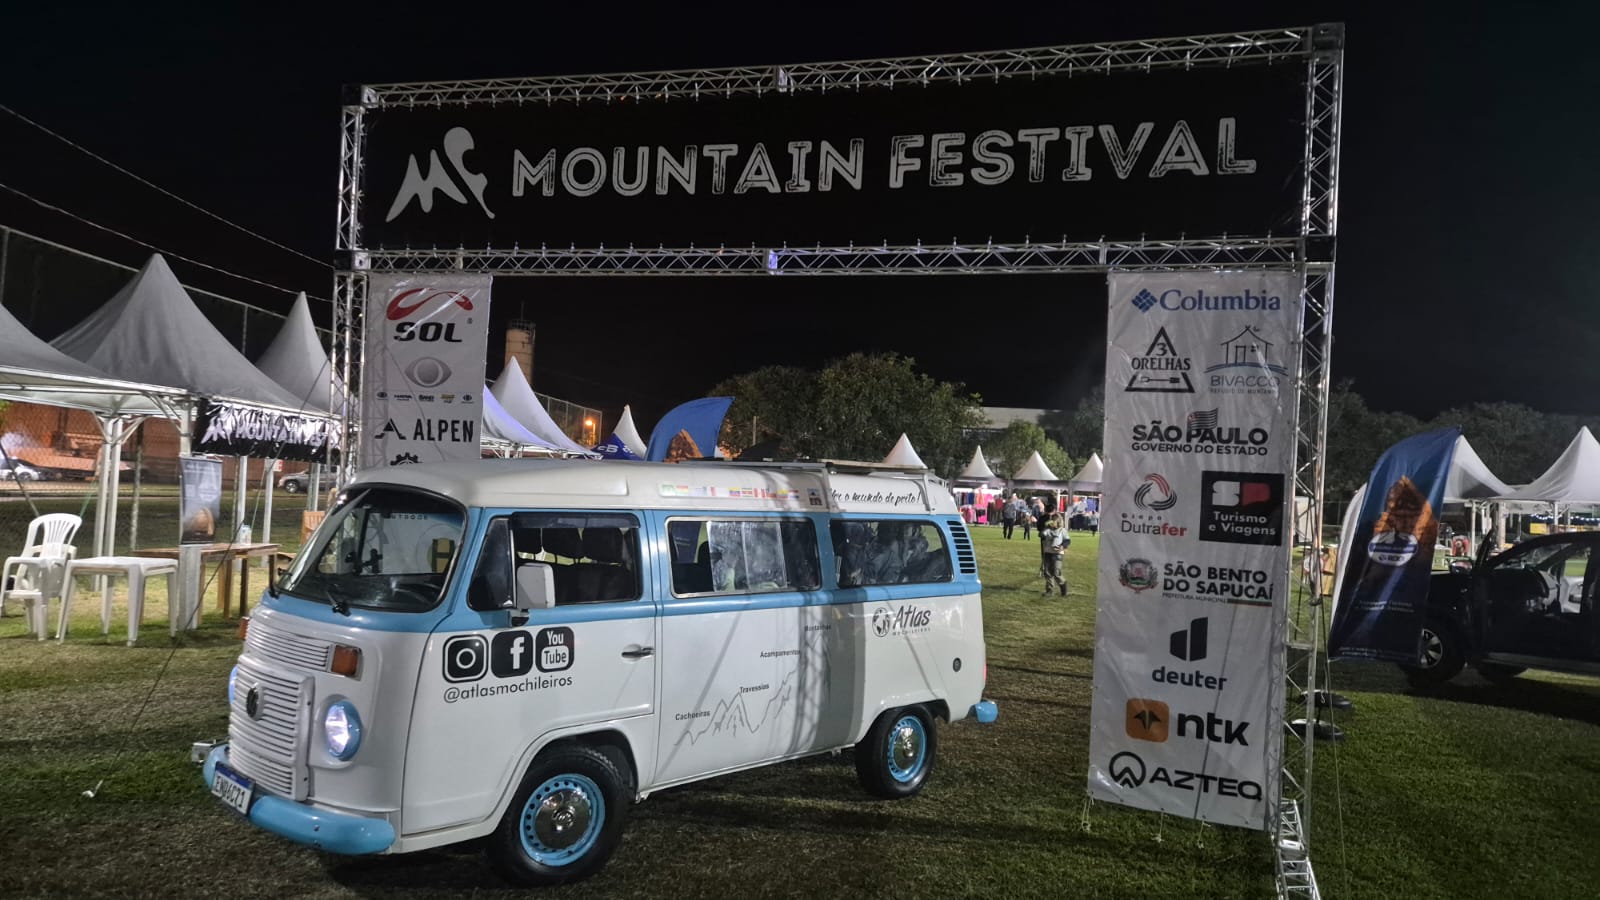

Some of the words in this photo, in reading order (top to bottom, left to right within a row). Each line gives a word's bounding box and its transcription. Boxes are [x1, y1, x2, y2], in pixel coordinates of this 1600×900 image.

[512, 138, 864, 197] MOUNTAIN
[888, 117, 1257, 189] FESTIVAL
[1159, 289, 1281, 312] Columbia
[393, 322, 463, 342] SOL
[1156, 342, 1168, 357] 3
[1131, 357, 1191, 371] ORELHAS
[1210, 375, 1281, 387] BIVACCO
[413, 418, 474, 443] ALPEN
[1132, 420, 1183, 443] SÃO
[1186, 427, 1269, 446] PAULO
[1131, 442, 1192, 454] GOVERNO
[1194, 444, 1214, 454] DO
[1216, 445, 1268, 456] ESTADO
[1214, 511, 1268, 523] Turismo
[1121, 520, 1188, 537] Dutrafer
[1208, 523, 1216, 532] e
[1221, 522, 1276, 536] Viagens
[1163, 561, 1201, 579] SÃO
[1207, 567, 1267, 584] BENTO
[1163, 578, 1190, 592] DO
[1196, 583, 1274, 600] SAPUCAÍ
[892, 604, 931, 630] Atlas
[546, 631, 564, 645] You
[544, 650, 567, 664] Tube
[1152, 666, 1227, 690] deuter
[443, 675, 573, 703] @atlasmochileiros
[1150, 767, 1263, 802] AZTEQ
